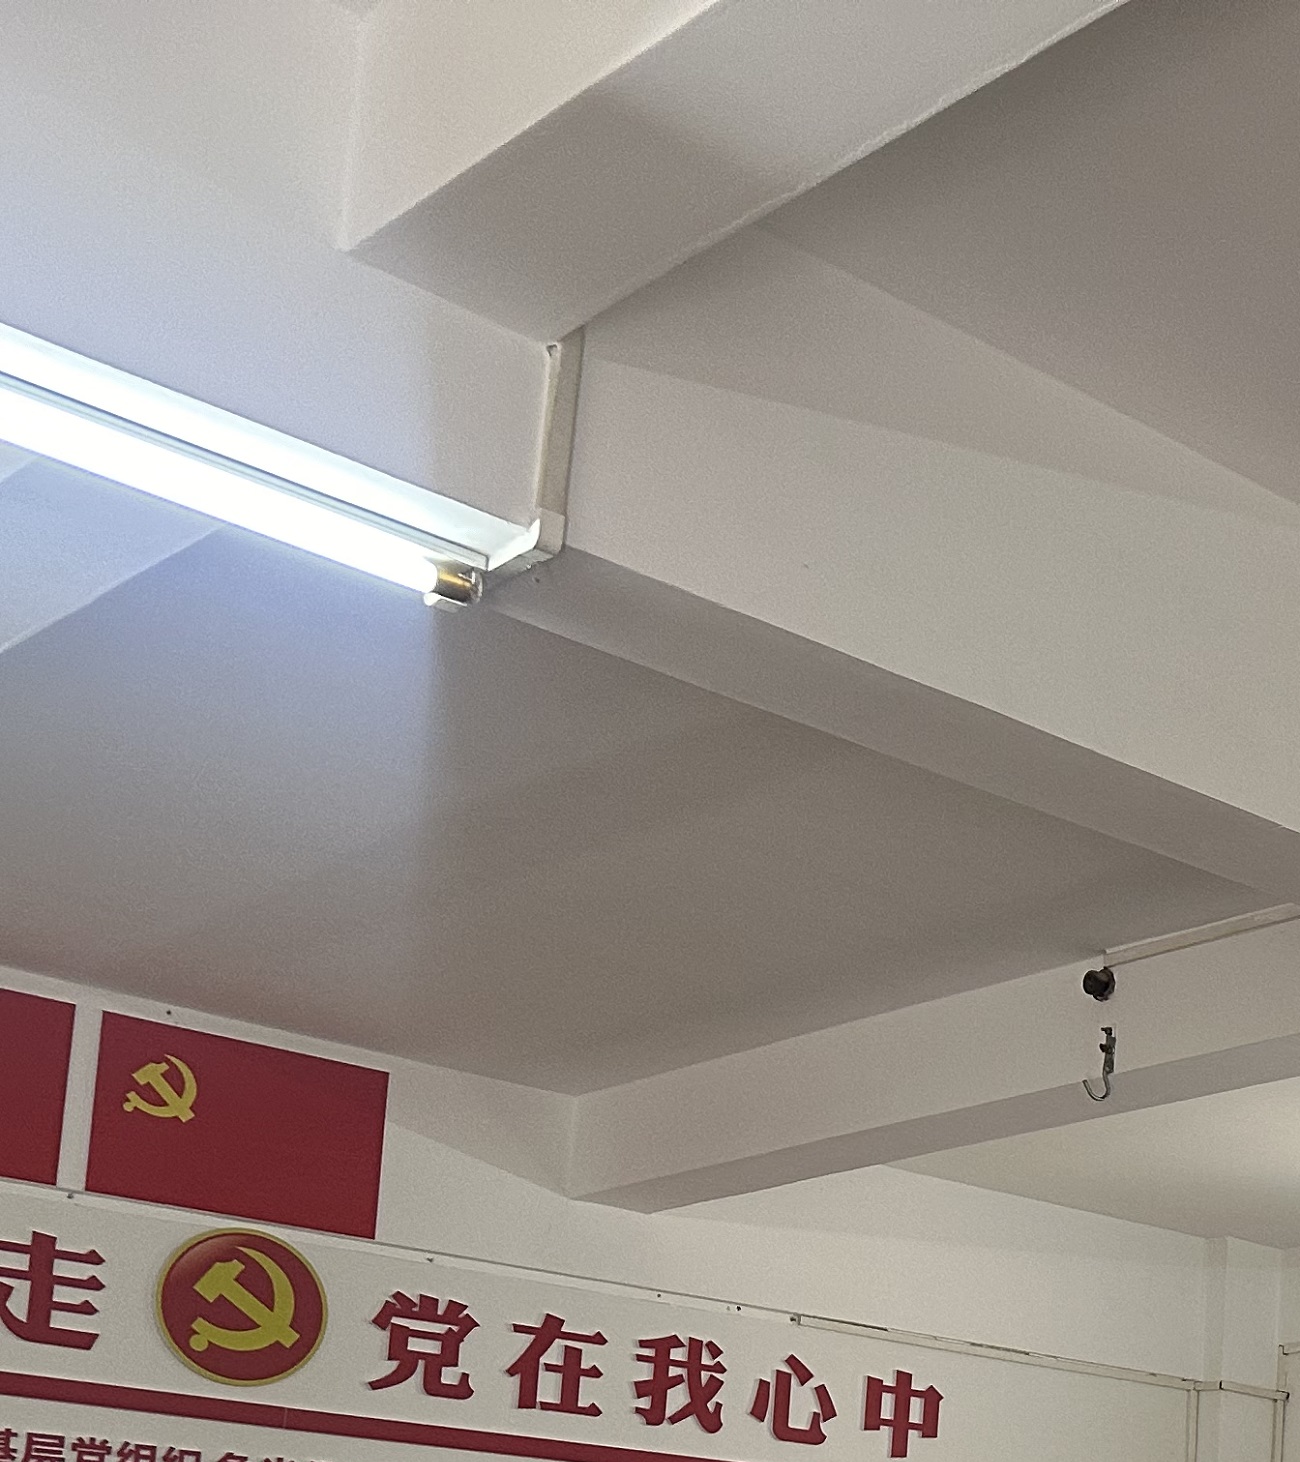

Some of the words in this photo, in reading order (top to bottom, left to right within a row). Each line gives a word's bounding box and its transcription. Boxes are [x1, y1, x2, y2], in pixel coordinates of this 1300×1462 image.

[0, 1230, 106, 1350] 走
[368, 1290, 944, 1458] 党在我心中
